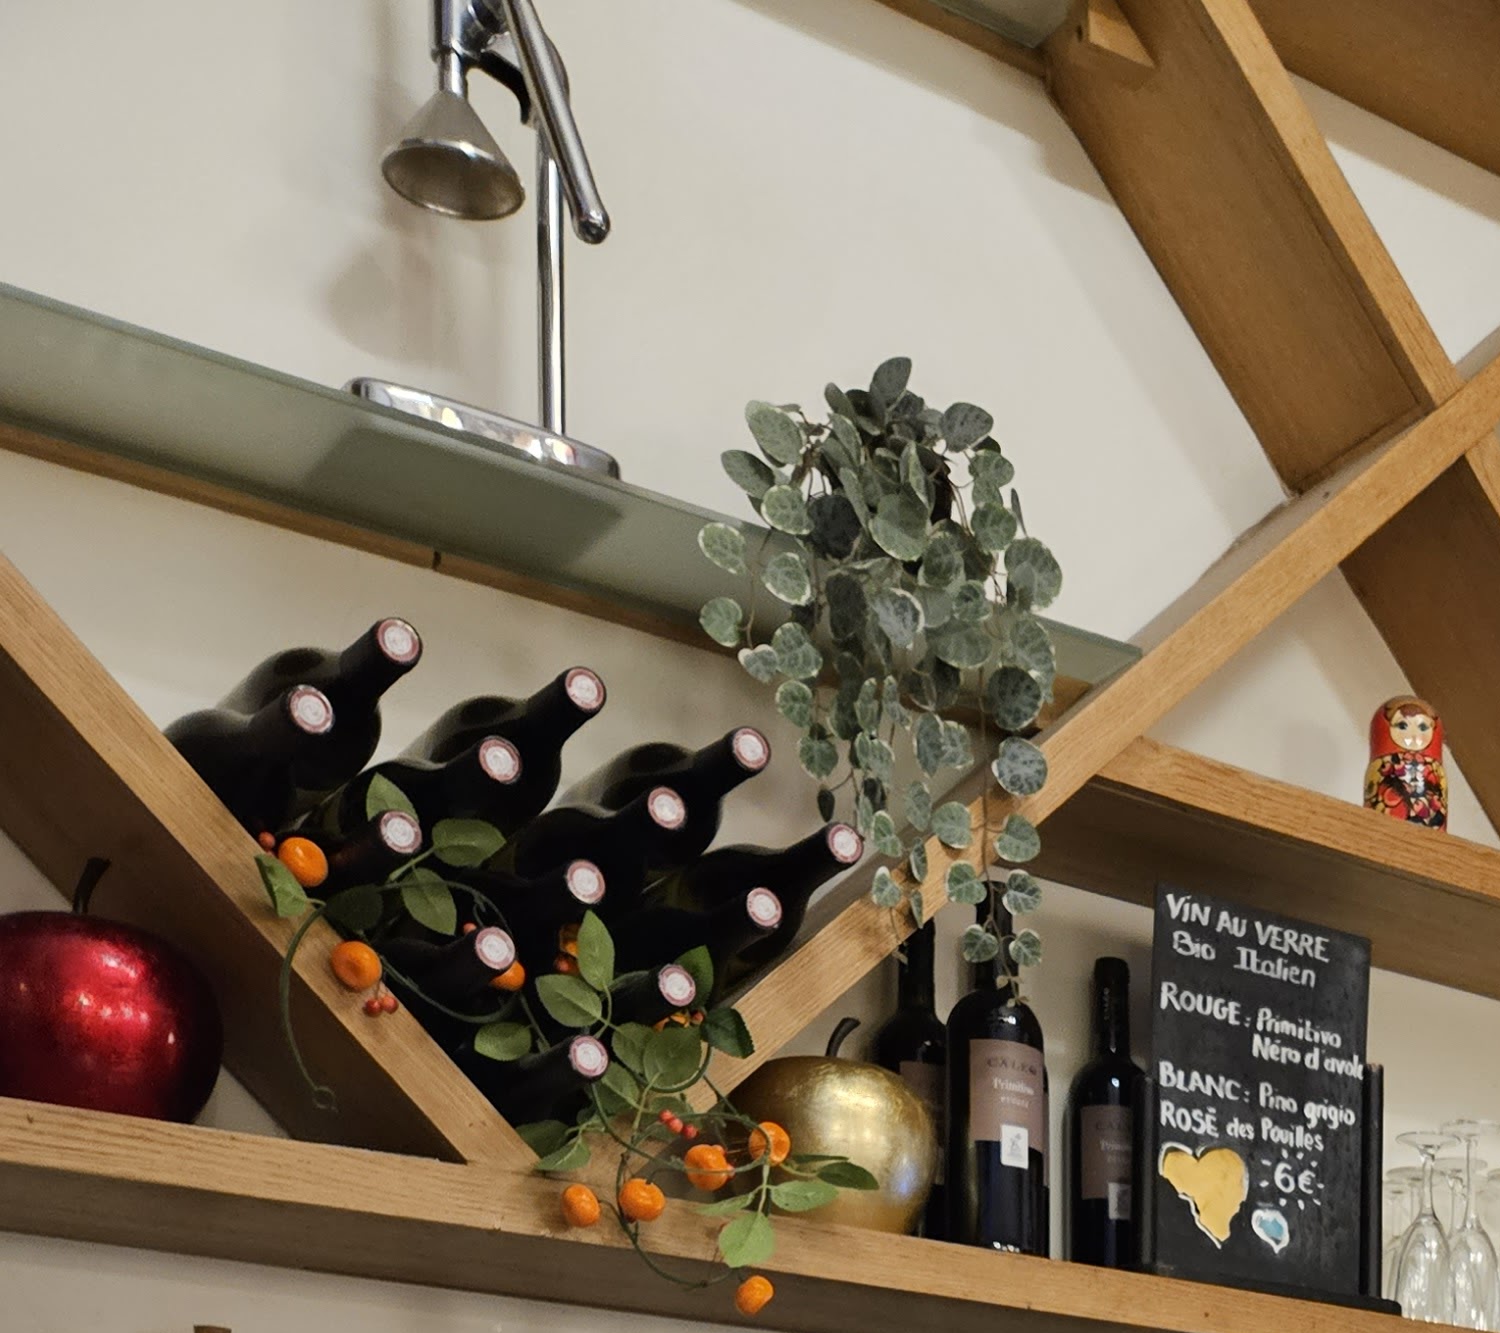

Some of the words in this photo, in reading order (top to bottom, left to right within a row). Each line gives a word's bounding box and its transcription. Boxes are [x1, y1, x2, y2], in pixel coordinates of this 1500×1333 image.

[1172, 930, 1216, 960] Bio
[1233, 946, 1316, 989] Italien
[1216, 911, 1247, 938] AU
[1254, 921, 1331, 963] VERRE
[1256, 1007, 1342, 1048] Primitivo
[1160, 1100, 1219, 1138] ROSÉ
[1226, 1117, 1254, 1140] des
[1260, 1116, 1324, 1151] Pouilles
[1259, 1082, 1298, 1113] Pino
[1303, 1099, 1356, 1130] grigio
